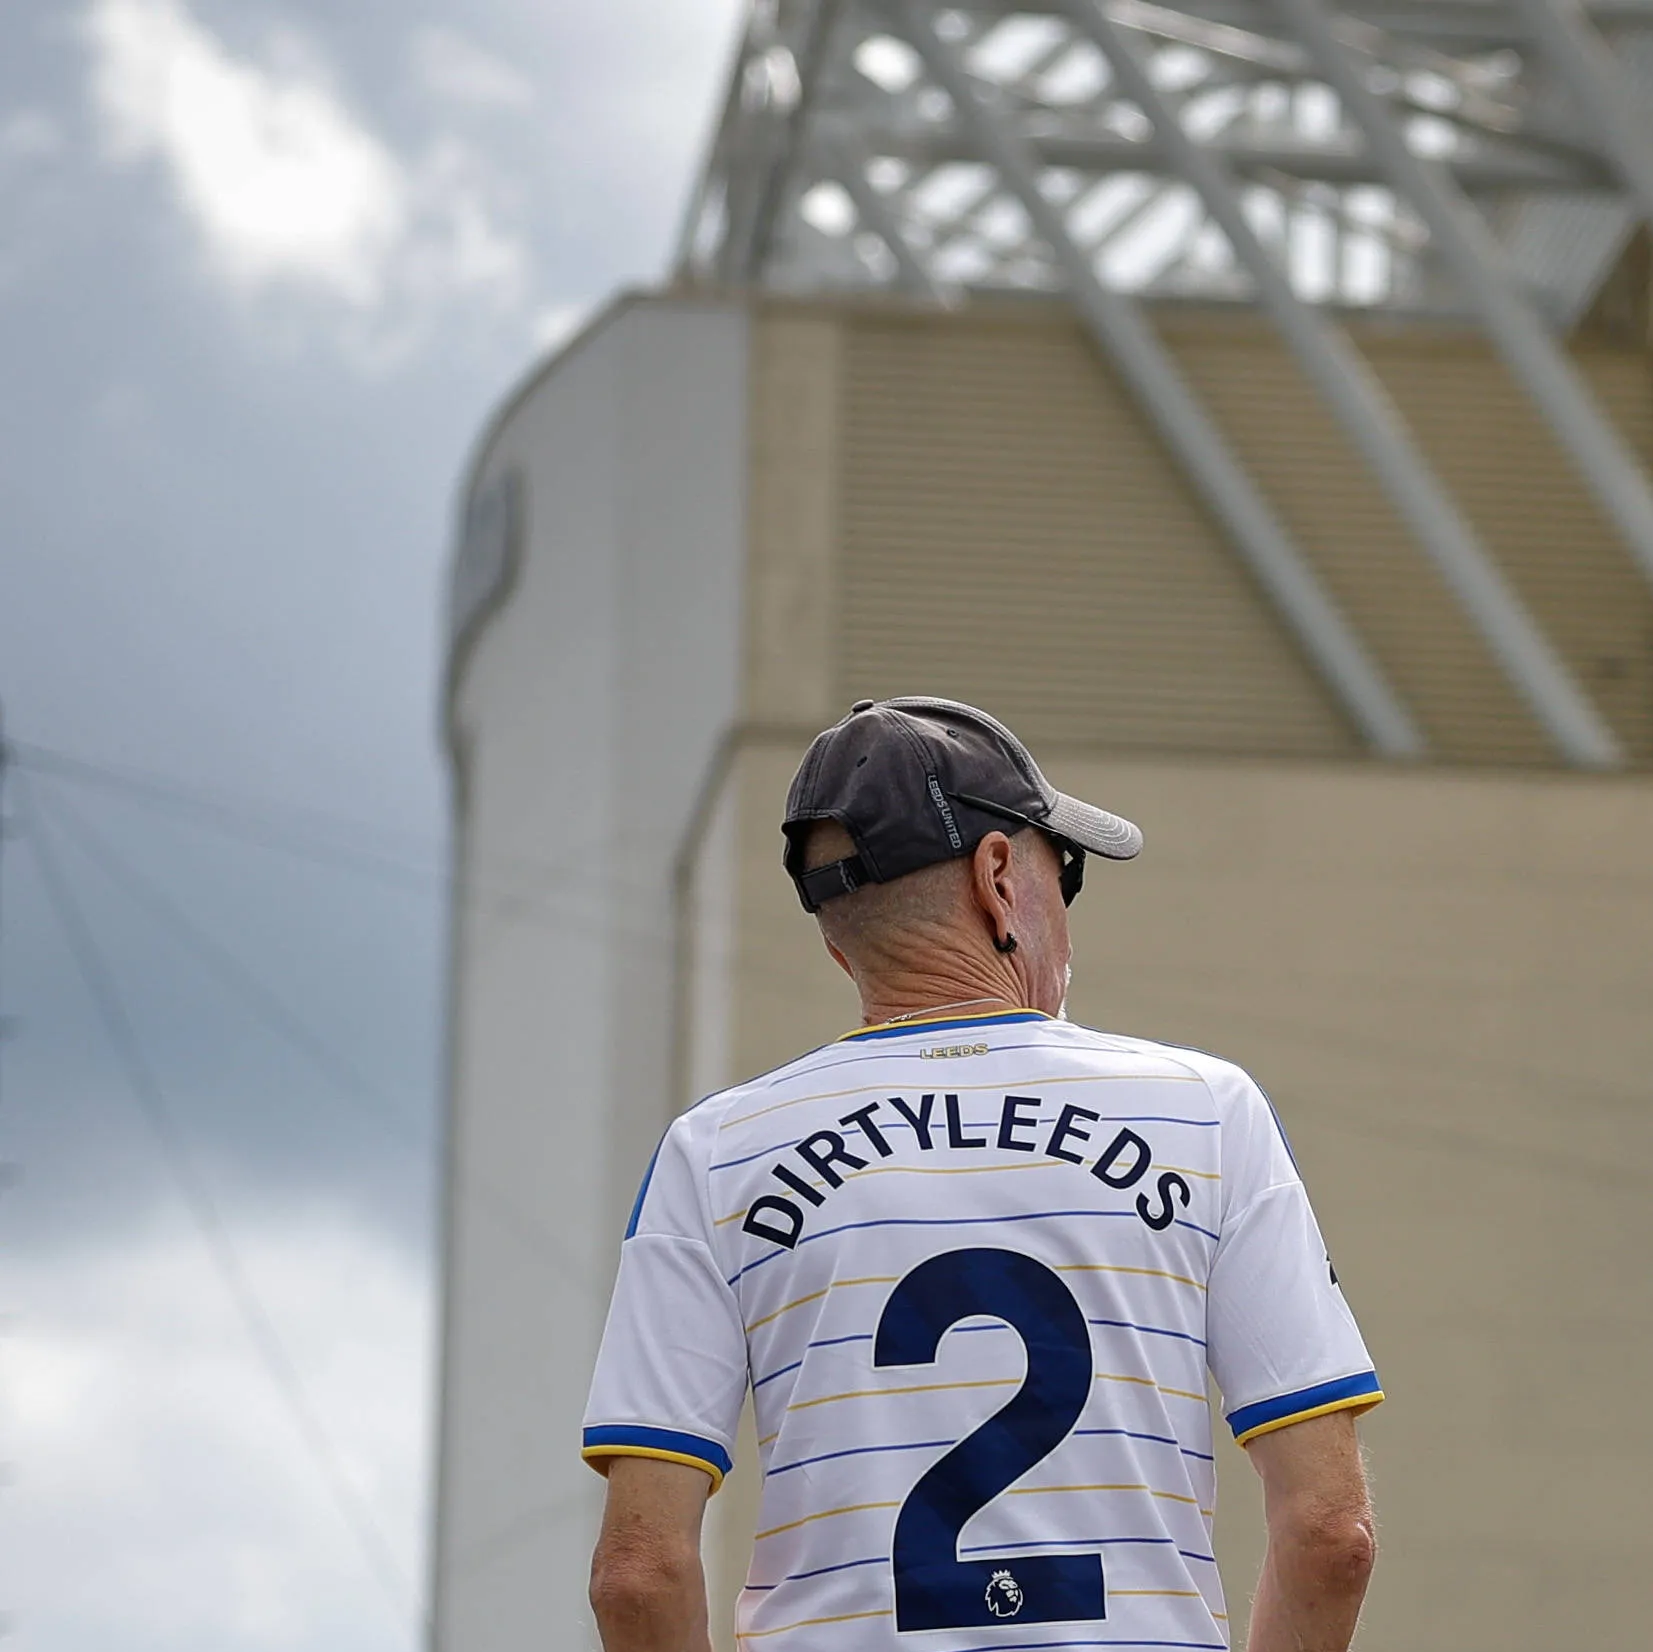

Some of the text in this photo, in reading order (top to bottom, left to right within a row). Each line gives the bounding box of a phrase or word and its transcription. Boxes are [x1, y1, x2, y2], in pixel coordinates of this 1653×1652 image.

[928, 775, 962, 849] LEEDS UNITED
[920, 1043, 989, 1060] LEEDS
[741, 1093, 1191, 1251] DIRTYLEEDS
[873, 1247, 1107, 1633] 2
